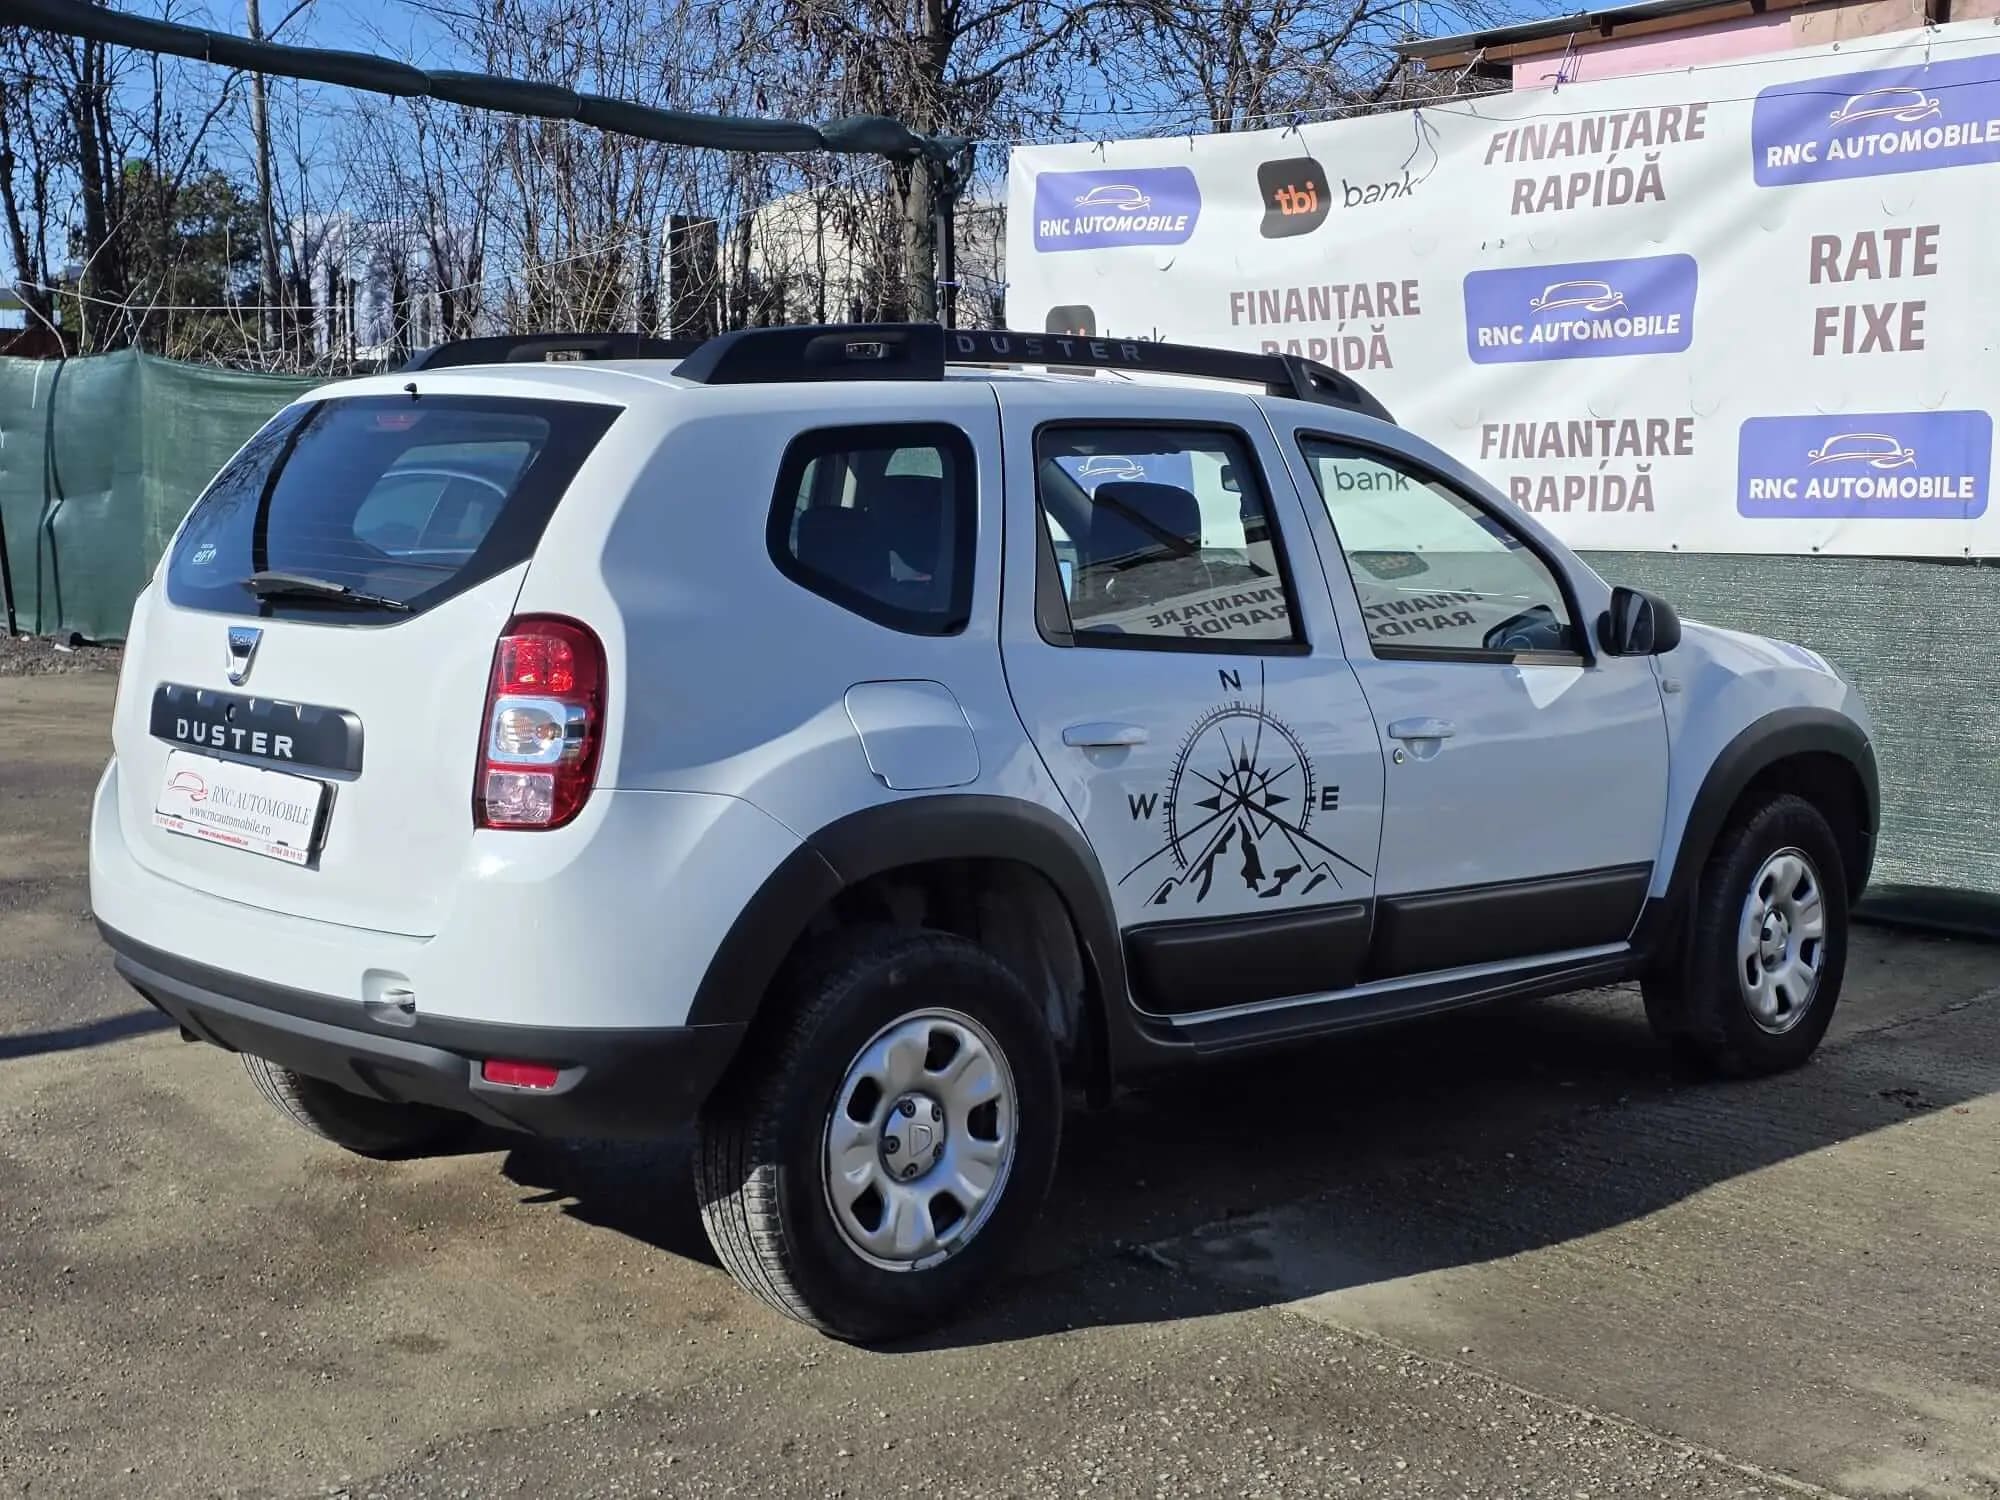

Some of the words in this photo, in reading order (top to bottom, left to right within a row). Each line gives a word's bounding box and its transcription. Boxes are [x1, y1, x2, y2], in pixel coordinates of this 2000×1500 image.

[1766, 141, 1818, 168] RNC
[1826, 119, 2000, 161] AUTOMOBILE
[1274, 180, 1319, 216] tbi
[1342, 170, 1420, 208] bank
[1511, 152, 1666, 216] RAPIDĂ
[1039, 218, 1071, 237] RNC
[1074, 215, 1188, 235] AUTOMOBILE
[1808, 224, 1940, 285] RATE
[1478, 325, 1524, 347] RNC
[1528, 313, 1681, 344] AUTOMOBILE
[1812, 300, 1927, 357] FIXE
[956, 335, 1142, 361] DUSTER
[1333, 465, 1410, 491] bank
[1509, 463, 1655, 513] RAPIDĂ
[1749, 477, 1799, 499] RNC
[1804, 476, 1975, 499] AUTOMOBILE
[1218, 669, 1242, 691] N
[176, 718, 293, 758] DUSTER
[212, 784, 234, 808] RNC
[237, 792, 311, 826] AUTOMOBILE
[1127, 793, 1158, 820] W
[1321, 785, 1340, 811] E
